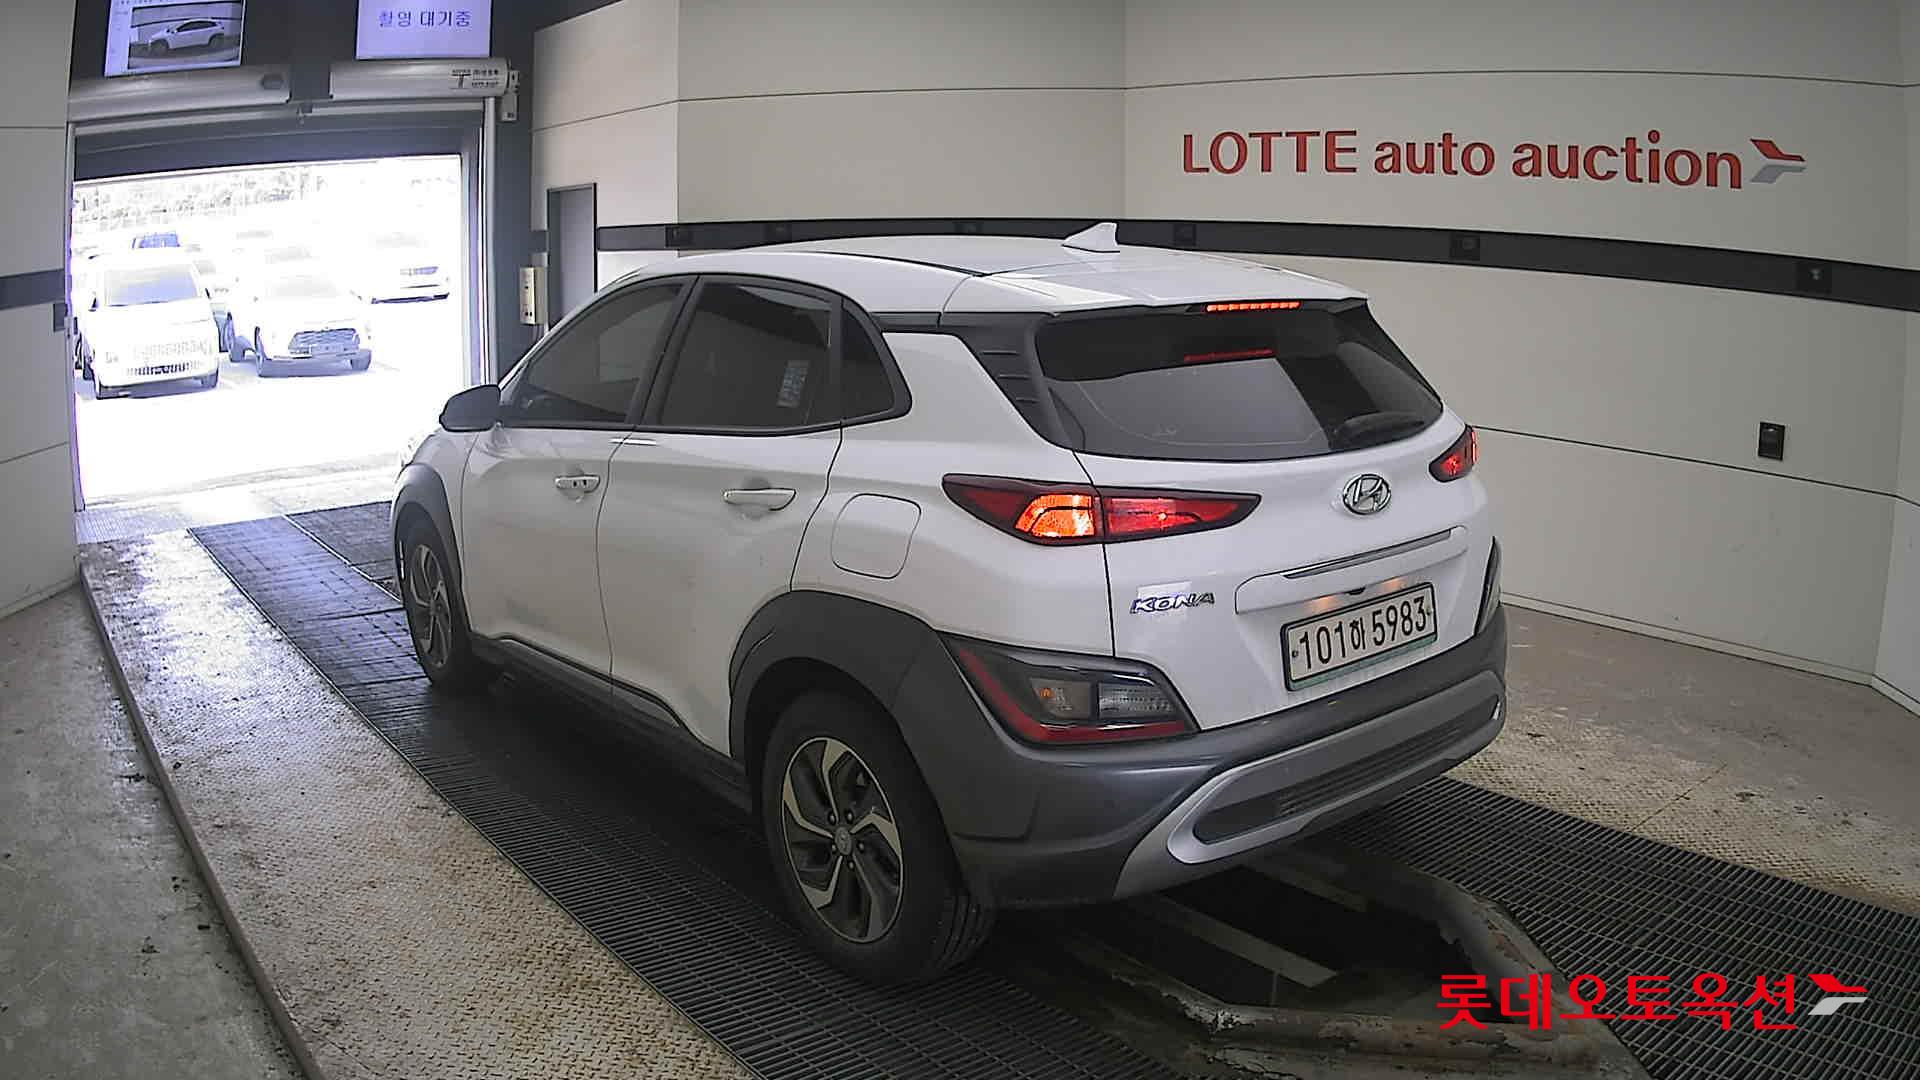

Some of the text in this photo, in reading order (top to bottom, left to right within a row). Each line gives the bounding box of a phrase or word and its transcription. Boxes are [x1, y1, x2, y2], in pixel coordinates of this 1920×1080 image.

[420, 10, 472, 28] 대기중
[1183, 129, 1742, 189] LOTTE auto auction
[1130, 591, 1215, 614] KONA
